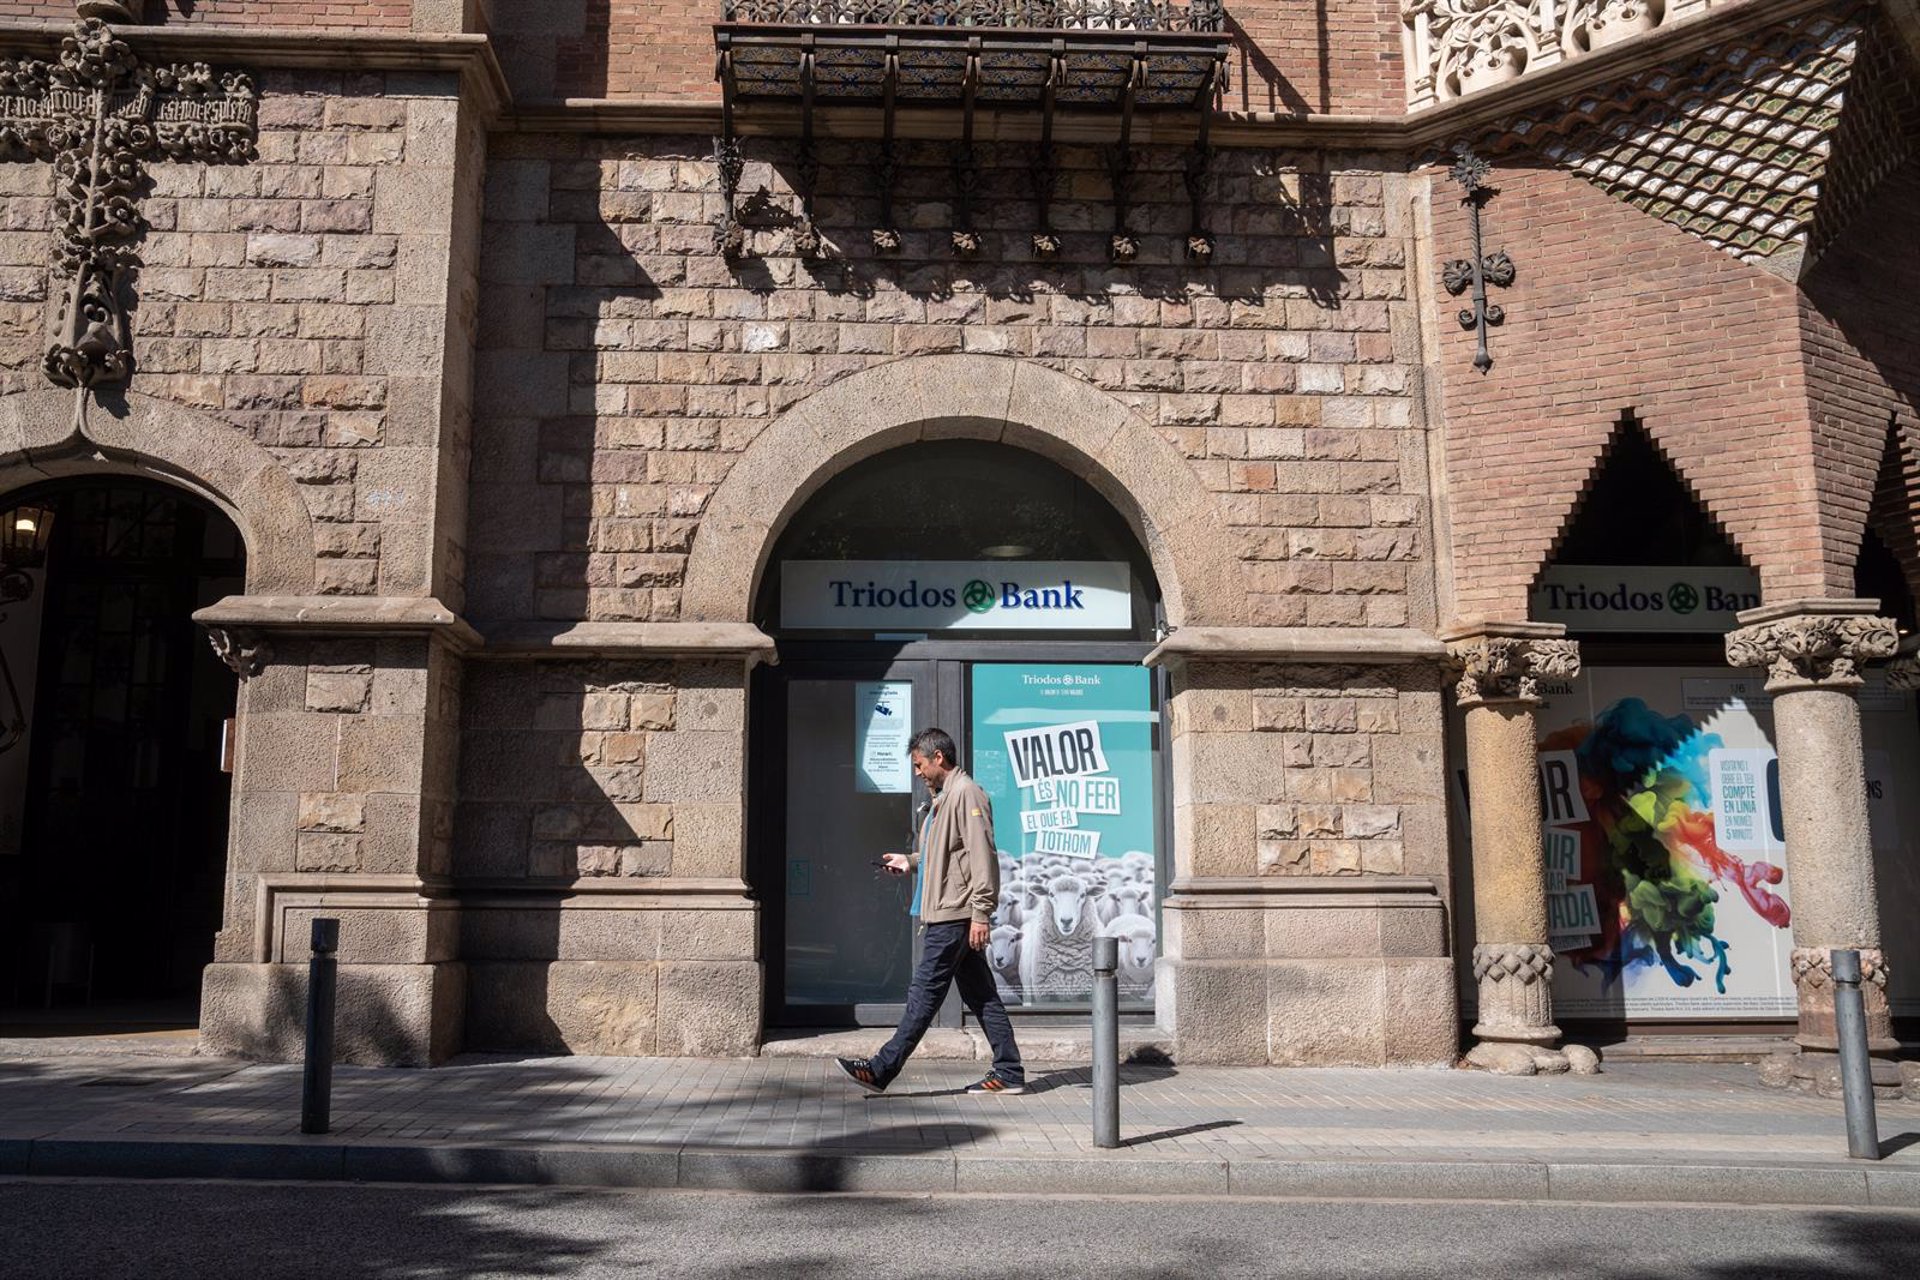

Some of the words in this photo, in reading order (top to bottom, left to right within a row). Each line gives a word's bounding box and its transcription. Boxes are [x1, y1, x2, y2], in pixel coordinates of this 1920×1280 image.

[829, 580, 956, 609] Triodos
[1000, 580, 1084, 610] Bank
[1543, 583, 1664, 612] Triodos
[1704, 586, 1760, 611] Ban
[1022, 674, 1061, 685] Triodos
[1075, 674, 1100, 685] Bank
[1011, 728, 1099, 781] VALOR
[1038, 778, 1053, 800] ÉS
[1056, 781, 1080, 809] NO
[1085, 780, 1116, 810] FER
[1722, 786, 1756, 799] COMPTE
[1866, 780, 1883, 799] NS
[1724, 800, 1735, 813] EN
[1026, 814, 1038, 830] EL
[1040, 811, 1058, 828] QUE
[1060, 809, 1073, 825] FA
[1041, 830, 1092, 855] TOTHOM
[1726, 828, 1731, 840] 5
